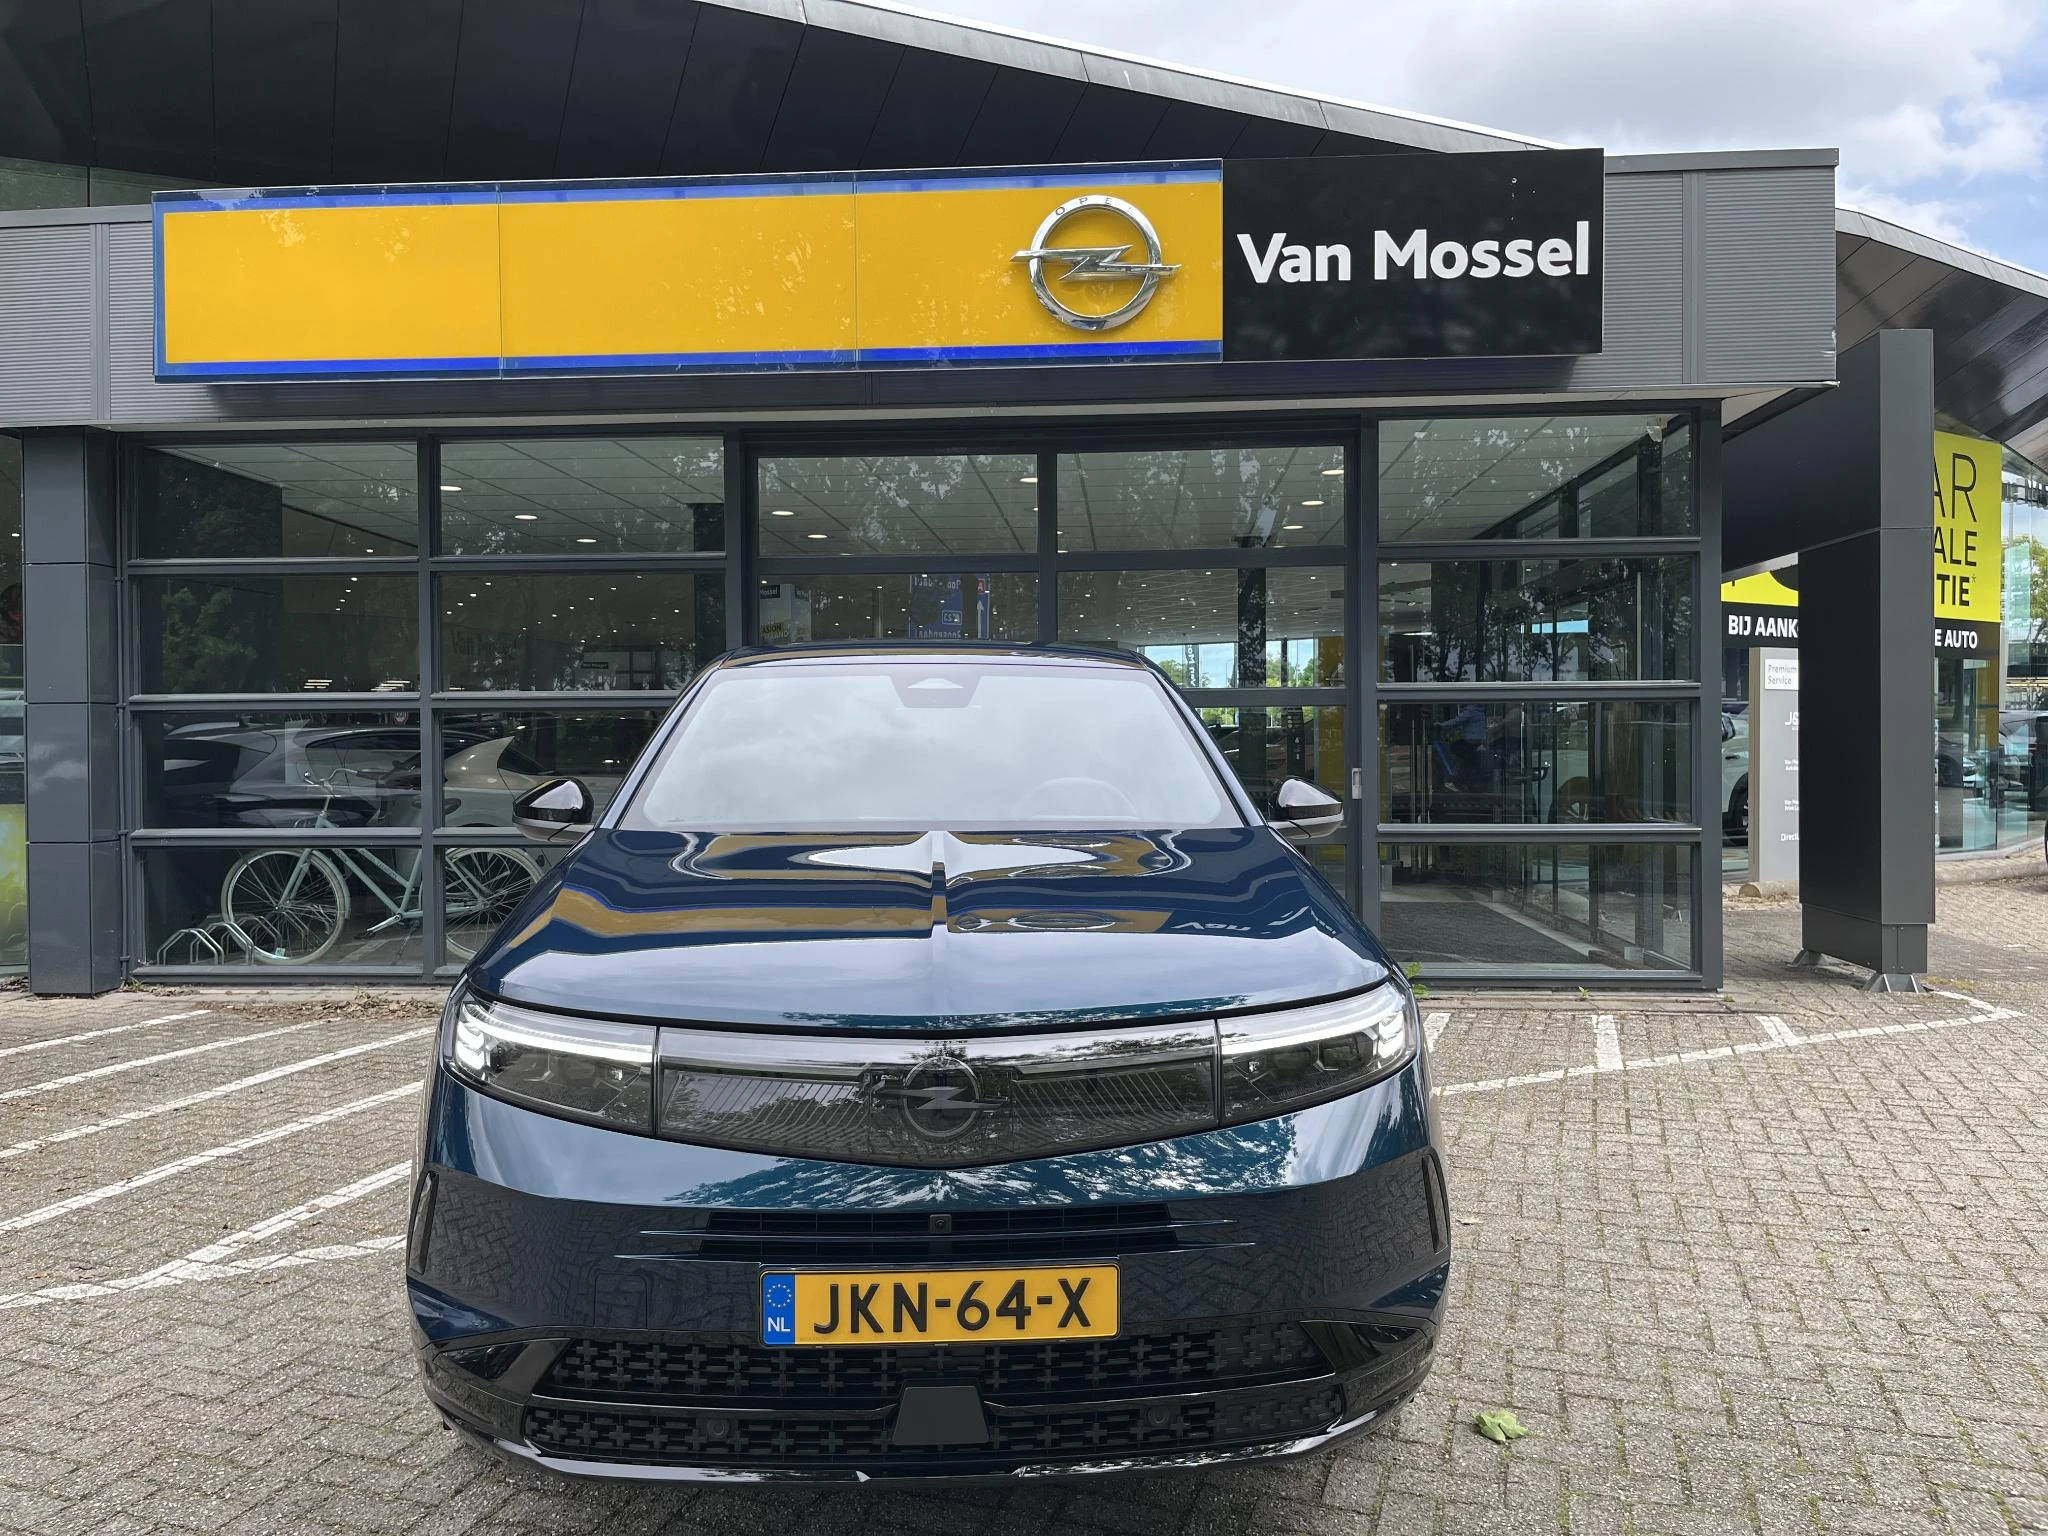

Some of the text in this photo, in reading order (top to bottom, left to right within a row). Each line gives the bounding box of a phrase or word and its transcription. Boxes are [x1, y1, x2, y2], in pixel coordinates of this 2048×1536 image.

[1055, 196, 1134, 216] OPEL
[1236, 221, 1590, 284] Van Mossel
[1934, 526, 1977, 567] ALE
[1728, 614, 1798, 638] BIJ AANK
[1934, 628, 1978, 648] E AUTO
[1767, 675, 1792, 685] Service
[767, 1277, 1093, 1335] NL JKN-64-X
